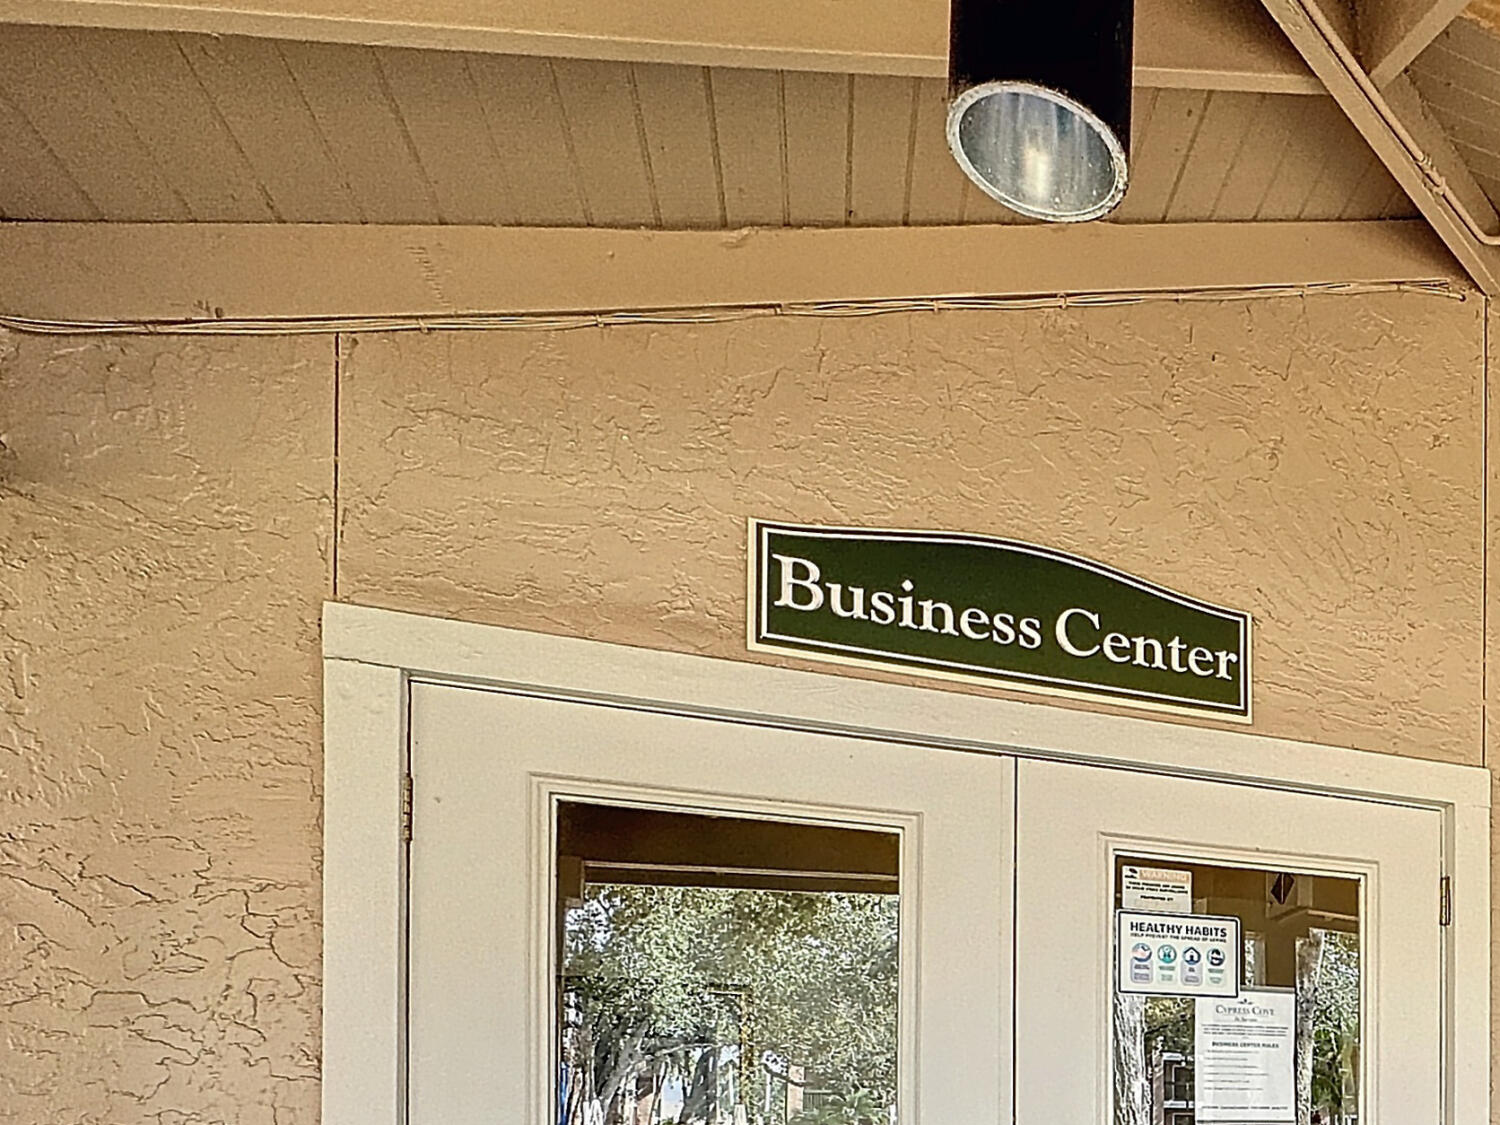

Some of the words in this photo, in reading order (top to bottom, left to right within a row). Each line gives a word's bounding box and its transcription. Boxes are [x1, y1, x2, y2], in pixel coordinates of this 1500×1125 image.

[772, 553, 1042, 649] Business
[1055, 607, 1239, 681] Center
[1142, 870, 1187, 881] WARNING
[1130, 921, 1183, 935] HEALTHY
[1185, 925, 1227, 938] HABITS
